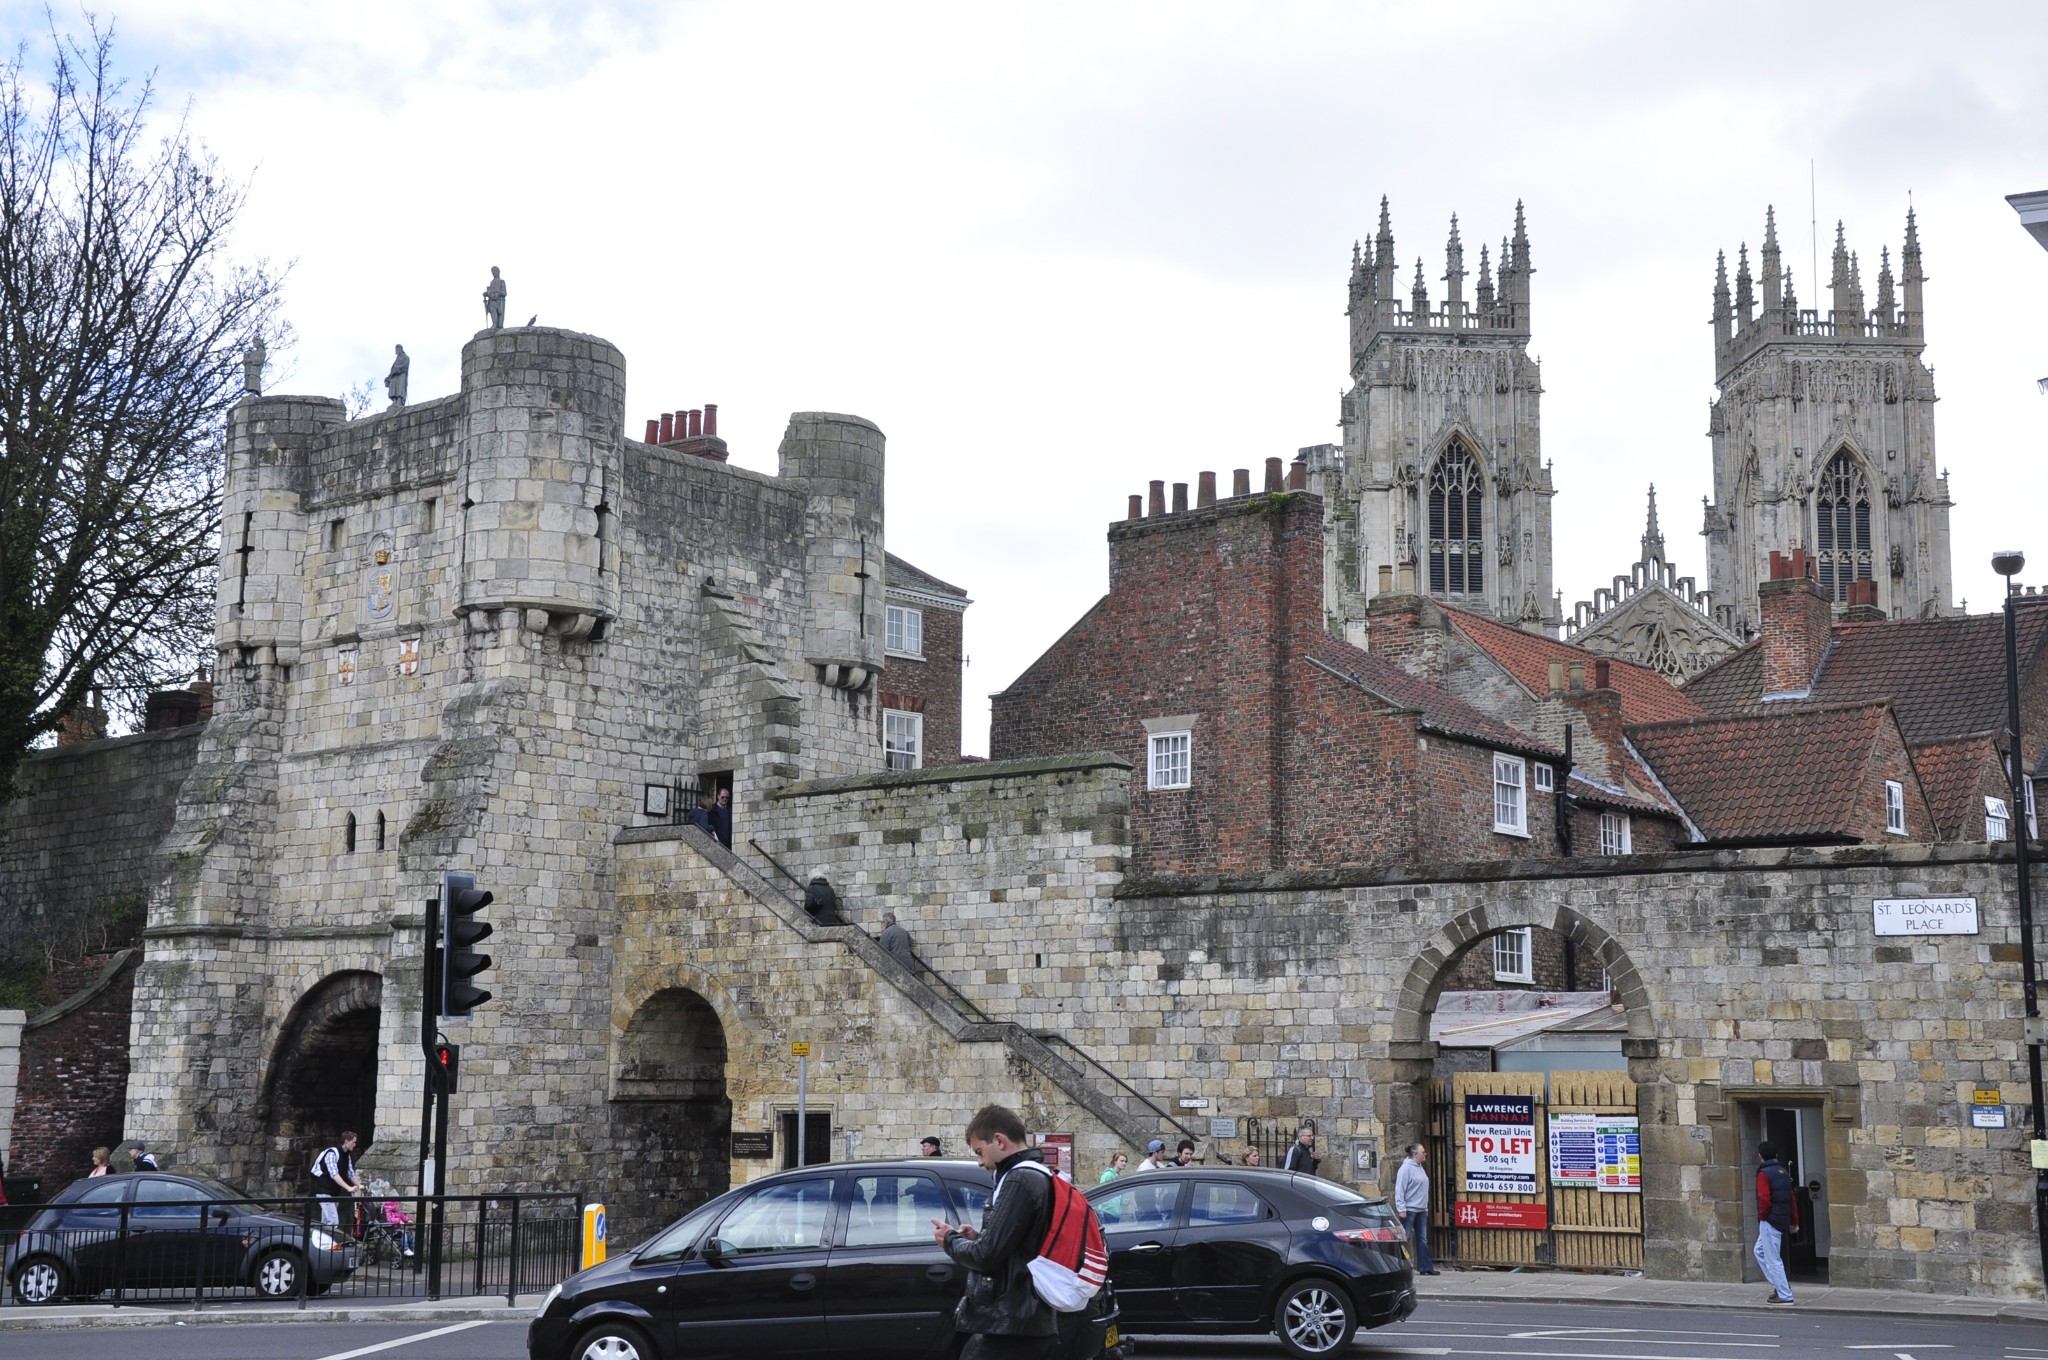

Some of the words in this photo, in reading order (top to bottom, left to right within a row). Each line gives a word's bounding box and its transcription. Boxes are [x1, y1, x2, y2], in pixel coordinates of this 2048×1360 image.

[1878, 904, 1892, 915] ST.
[1902, 903, 1972, 915] LEONARD'S
[1906, 919, 1944, 930] PLACE
[1469, 1104, 1529, 1114] LAWRENCE
[1470, 1114, 1529, 1122] HANNAH
[1468, 1126, 1486, 1135] New
[1489, 1127, 1512, 1136] Retail
[1514, 1128, 1532, 1136] Unit
[1468, 1137, 1494, 1154] TO
[1500, 1138, 1532, 1154] LET
[1484, 1156, 1498, 1164] 500
[1468, 1182, 1494, 1190] 01904
[1499, 1183, 1514, 1191] 659
[1518, 1184, 1533, 1192] 800
